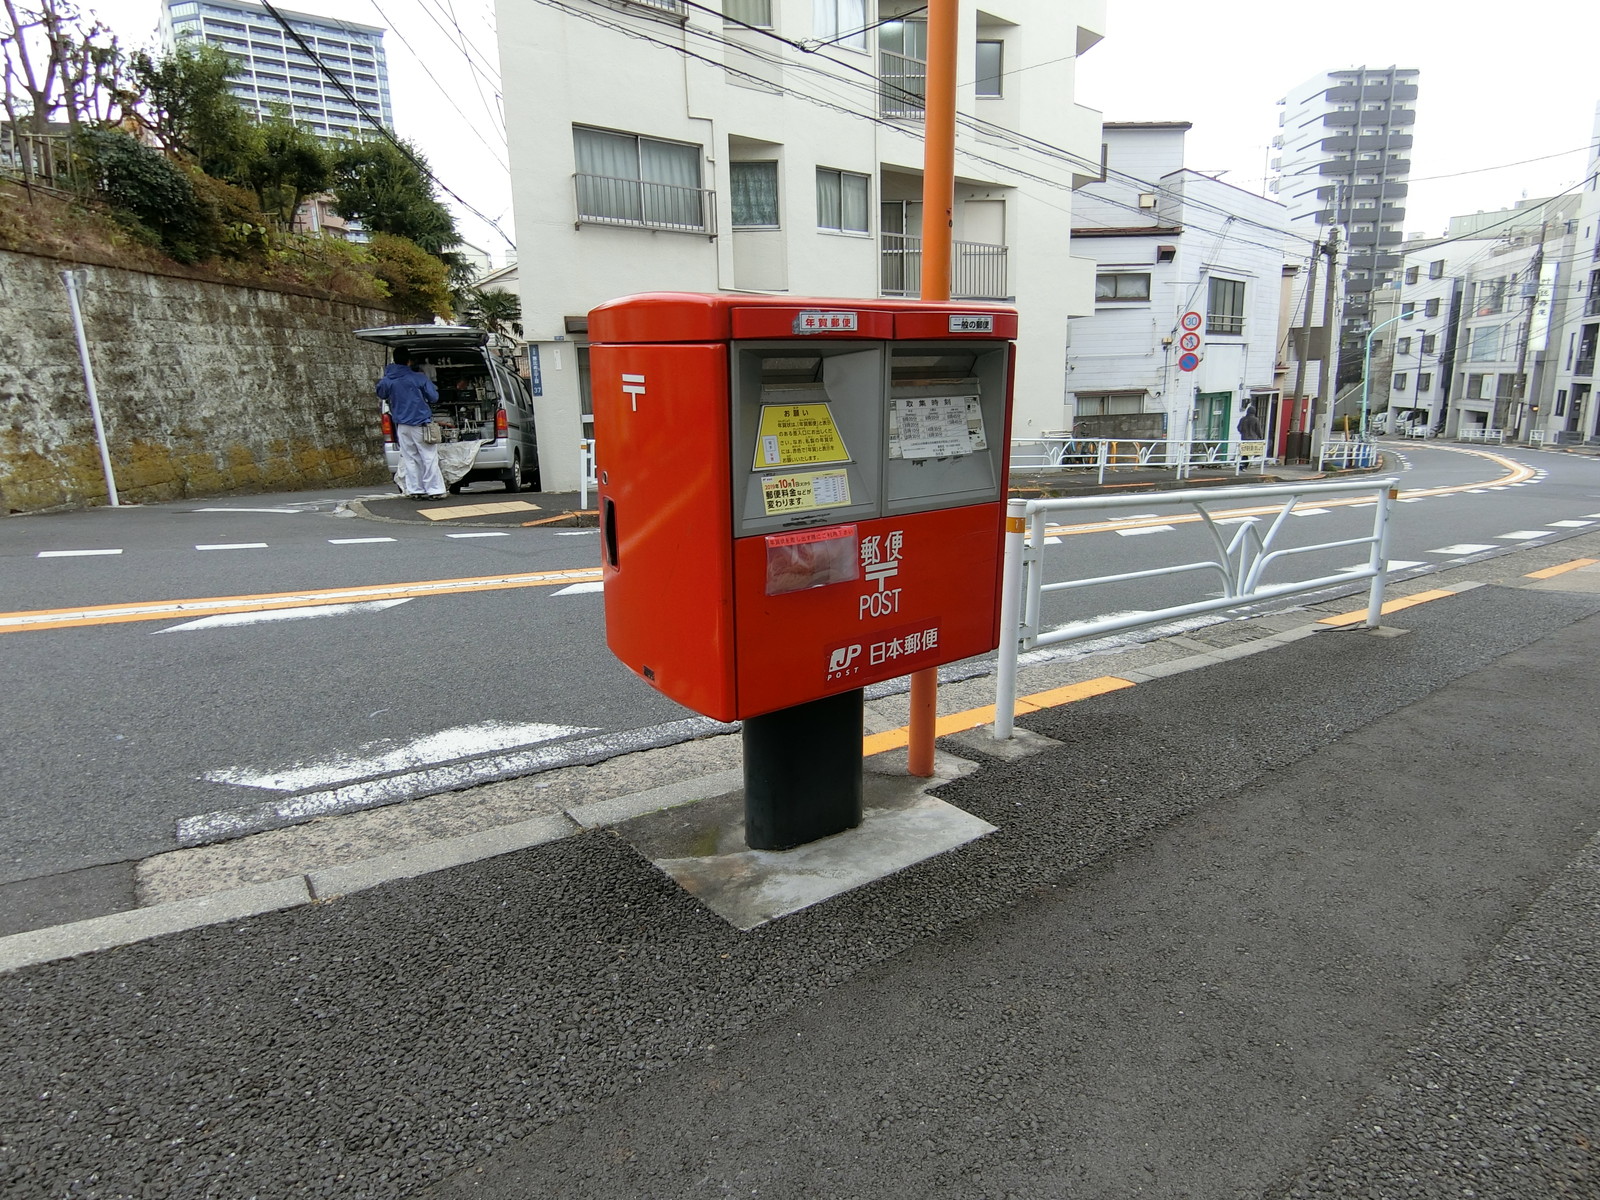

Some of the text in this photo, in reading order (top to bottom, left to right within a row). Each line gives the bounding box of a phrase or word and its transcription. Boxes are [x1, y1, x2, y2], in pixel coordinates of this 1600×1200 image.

[804, 317, 852, 328] 年賀郵便
[953, 320, 990, 330] 一般の郵便
[1186, 317, 1198, 326] 30
[905, 398, 952, 408] 取集時刻
[783, 409, 809, 417] お願い
[765, 488, 812, 500] 郵便料金などが
[766, 497, 804, 509] 変わります。
[860, 530, 904, 567] 郵便
[859, 588, 902, 620] POST
[869, 627, 938, 666] 日本郵便
[826, 667, 859, 681] POST
